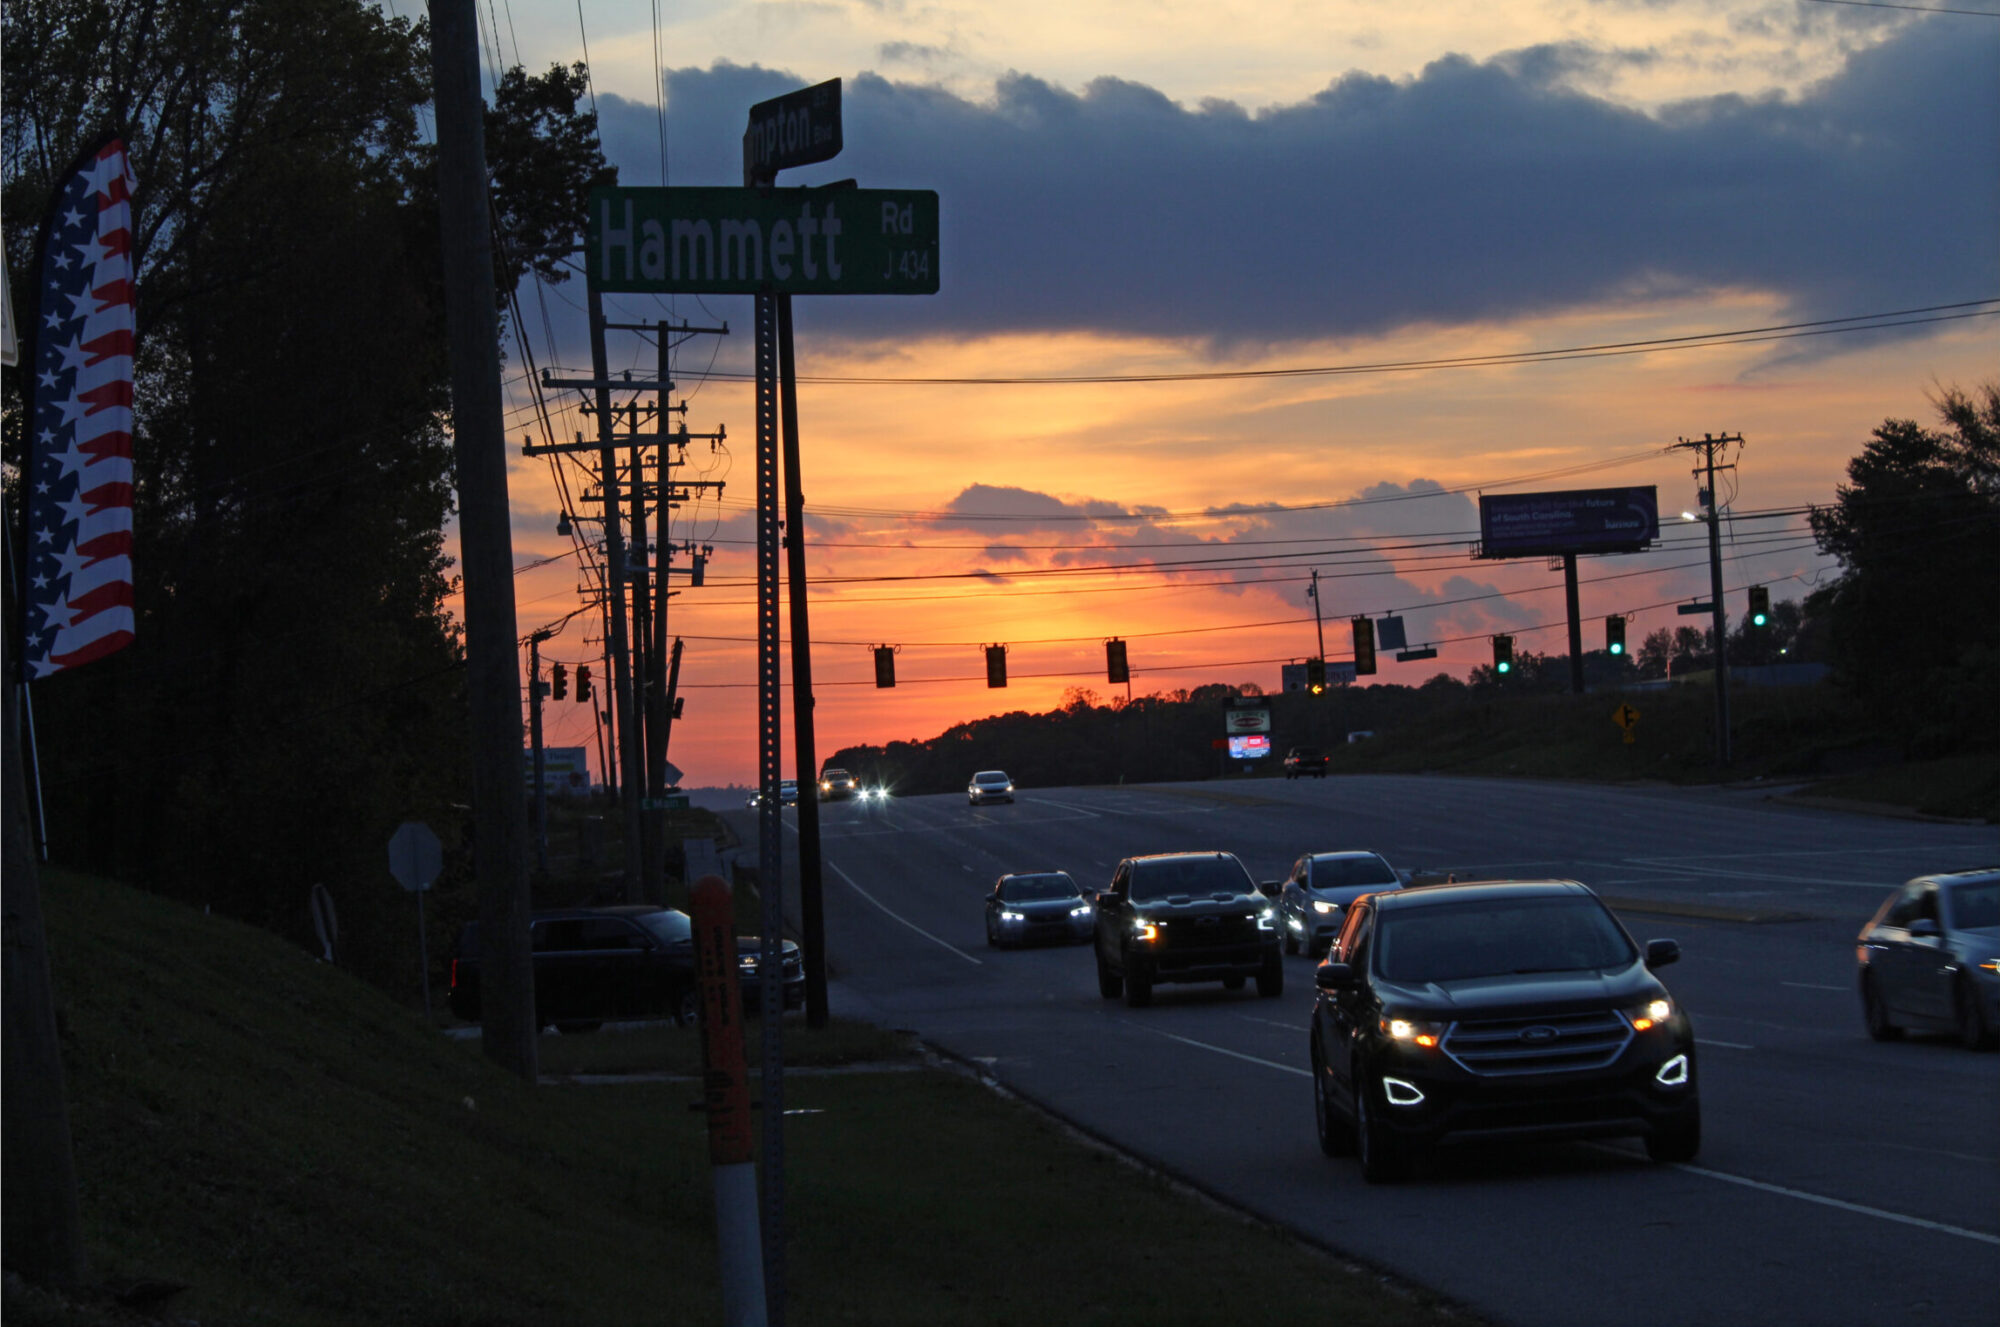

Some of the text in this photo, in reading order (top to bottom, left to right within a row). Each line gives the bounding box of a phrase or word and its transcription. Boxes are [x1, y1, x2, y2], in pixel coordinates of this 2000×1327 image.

[881, 200, 914, 235] Rd
[601, 198, 843, 281] Hammett
[898, 249, 929, 280] 434
[1491, 514, 1502, 523] of
[1503, 512, 1530, 522] South
[1586, 498, 1615, 508] future
